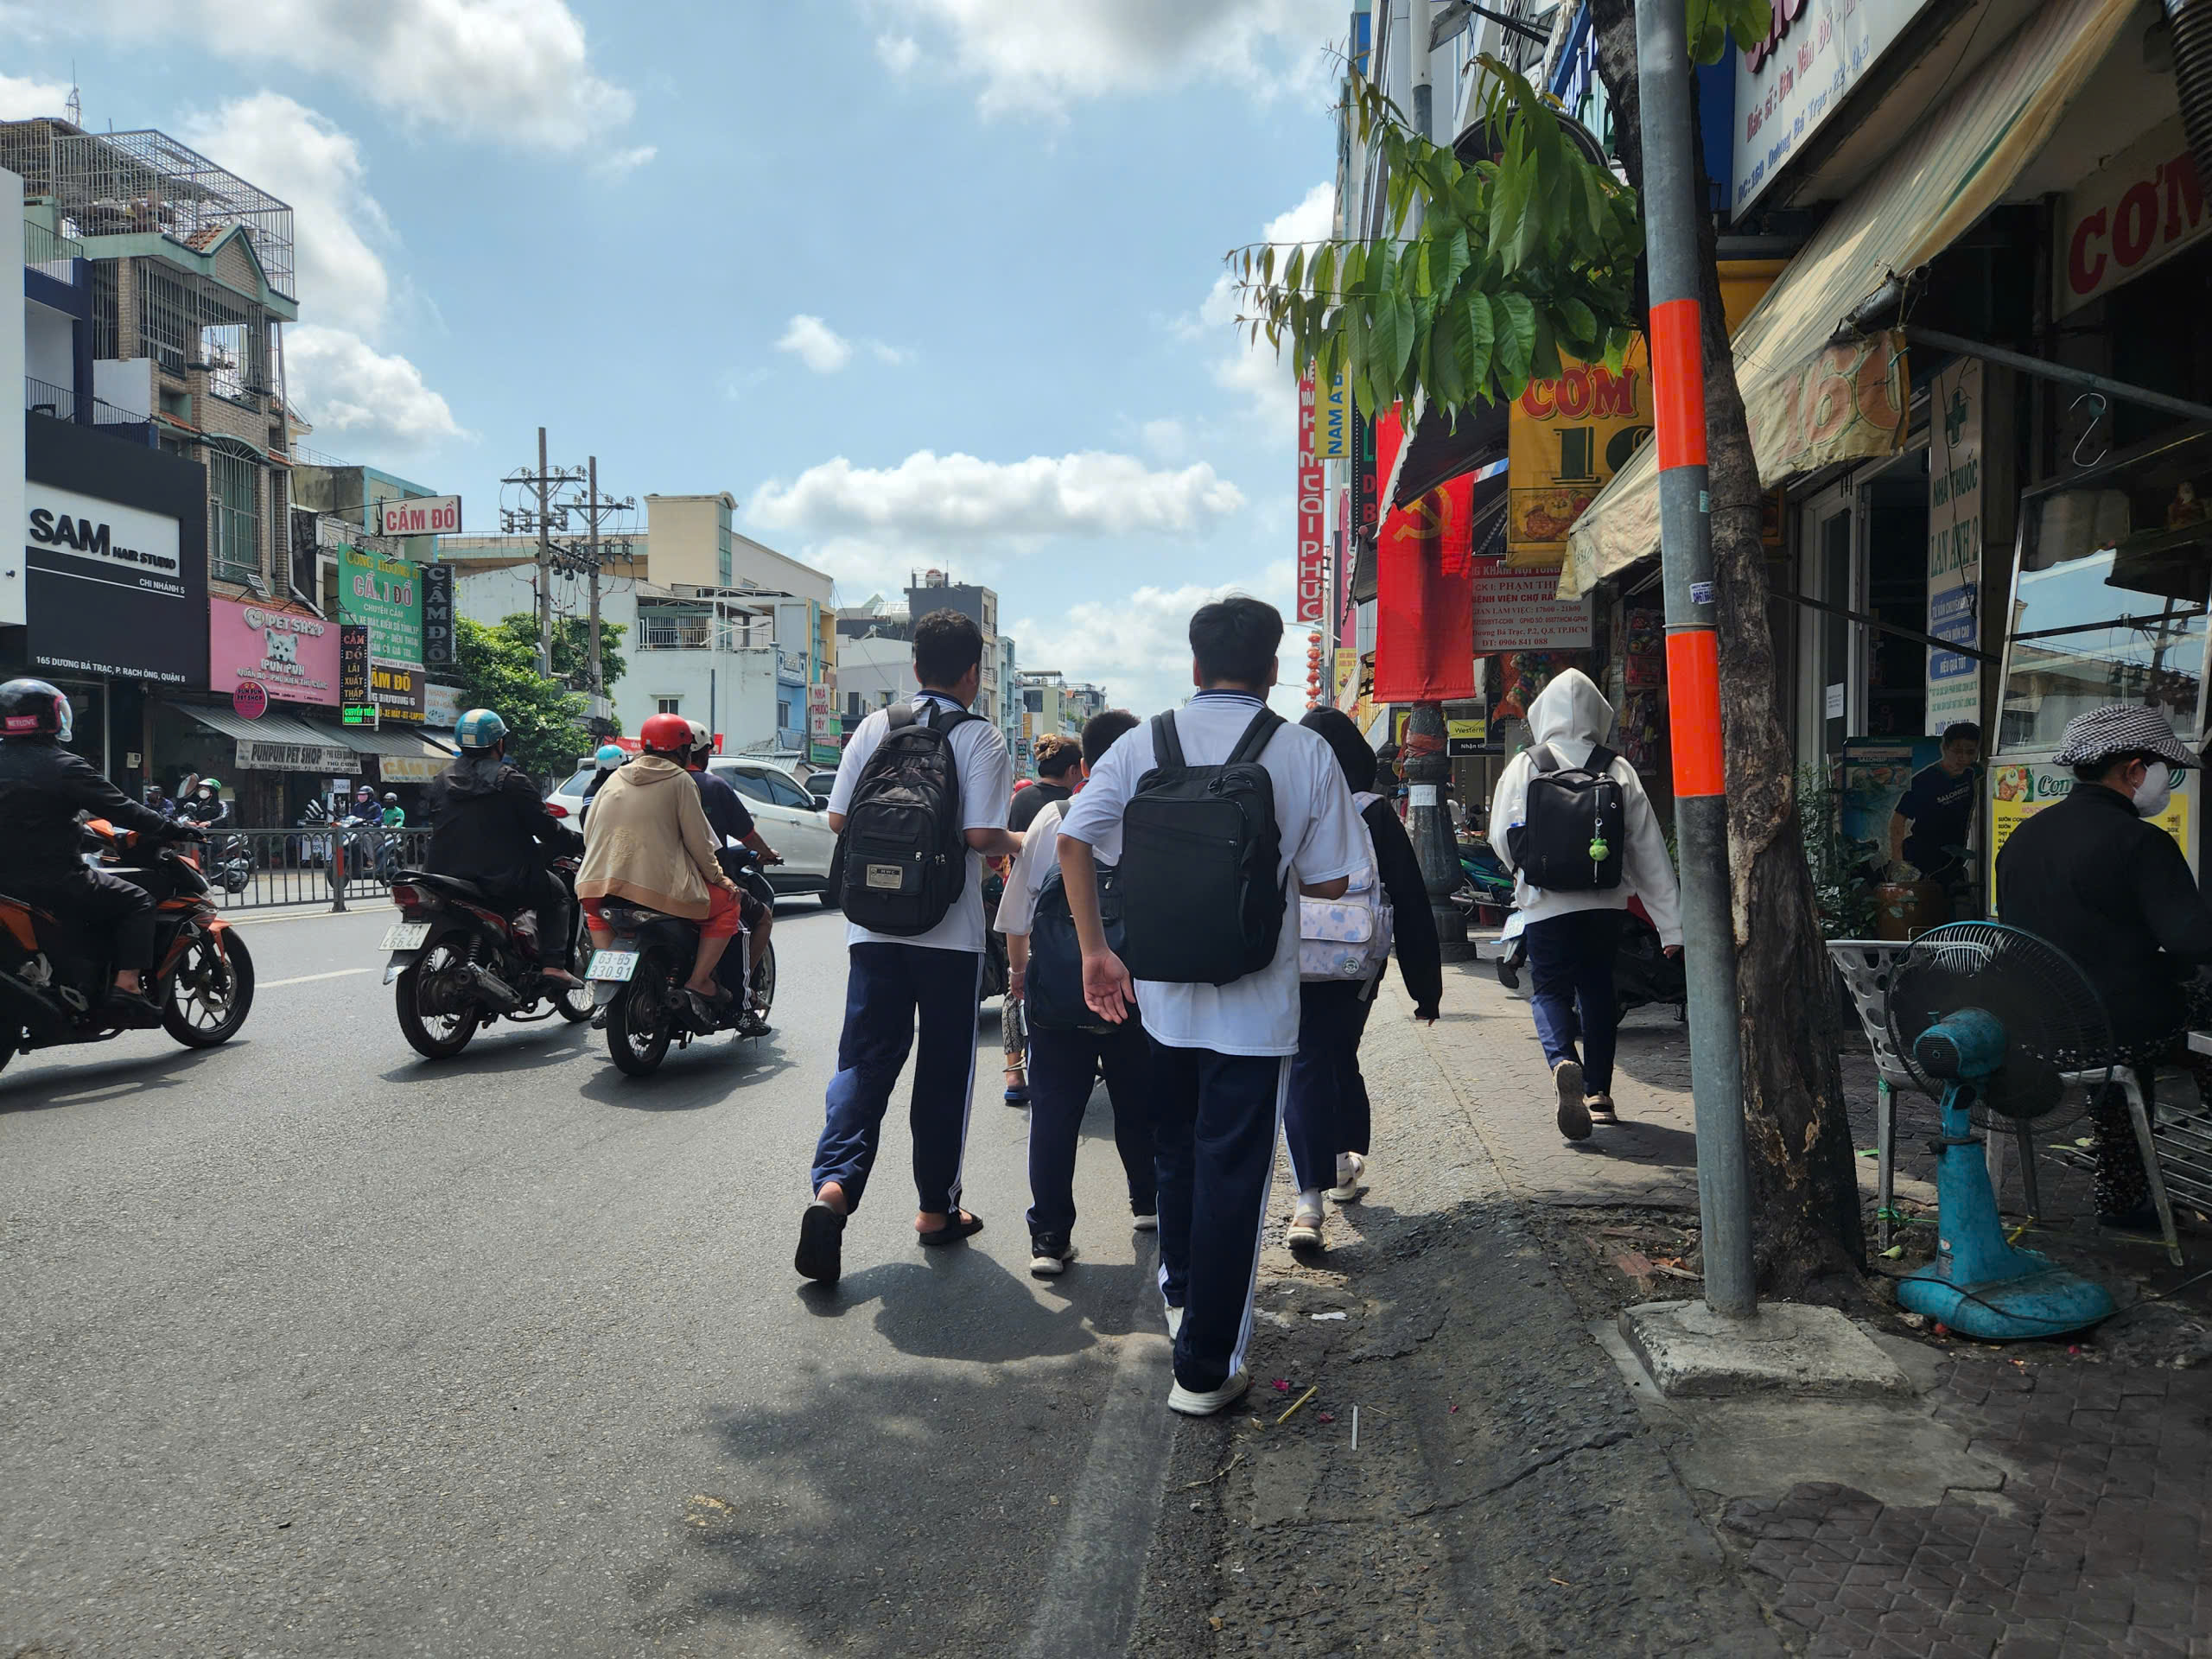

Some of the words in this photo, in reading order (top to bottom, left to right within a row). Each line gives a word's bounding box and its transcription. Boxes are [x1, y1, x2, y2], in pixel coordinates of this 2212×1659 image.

[1328, 409, 1342, 454] NAM
[386, 504, 425, 531] CẦM
[431, 500, 455, 529] ĐỒ
[29, 508, 110, 556] SAM
[112, 546, 139, 562] HAIR
[140, 552, 176, 570] STUDIO
[139, 578, 152, 588] CHI
[153, 580, 179, 593] NHÁNH
[1499, 582, 1533, 592] PHẠM
[1497, 594, 1518, 603] VIỆN
[1521, 594, 1539, 602] CHỢ
[265, 613, 290, 631] PET
[343, 630, 365, 645] CẦM
[345, 645, 363, 660] ĐỒ
[36, 656, 50, 664] 165
[52, 658, 79, 669] DƯƠNG
[80, 660, 92, 671] BÁ
[92, 663, 114, 675] TRẠC,
[123, 667, 143, 677] RẠCH
[162, 671, 180, 683] QUẬN
[261, 658, 283, 672] PUN
[283, 663, 305, 677] PUN
[344, 674, 363, 685] XUẤT
[371, 664, 391, 690] ẦM
[394, 671, 411, 692] ĐỒ
[344, 687, 365, 698] THẤP
[815, 687, 825, 699] NHÀ
[811, 700, 829, 715] THUỐC
[815, 717, 825, 731] TÂY
[251, 744, 286, 762] PUNPUN
[286, 747, 300, 764] PET
[301, 747, 322, 765] SHOP
[599, 952, 632, 966] 63-B5
[590, 965, 632, 979] 330.91
